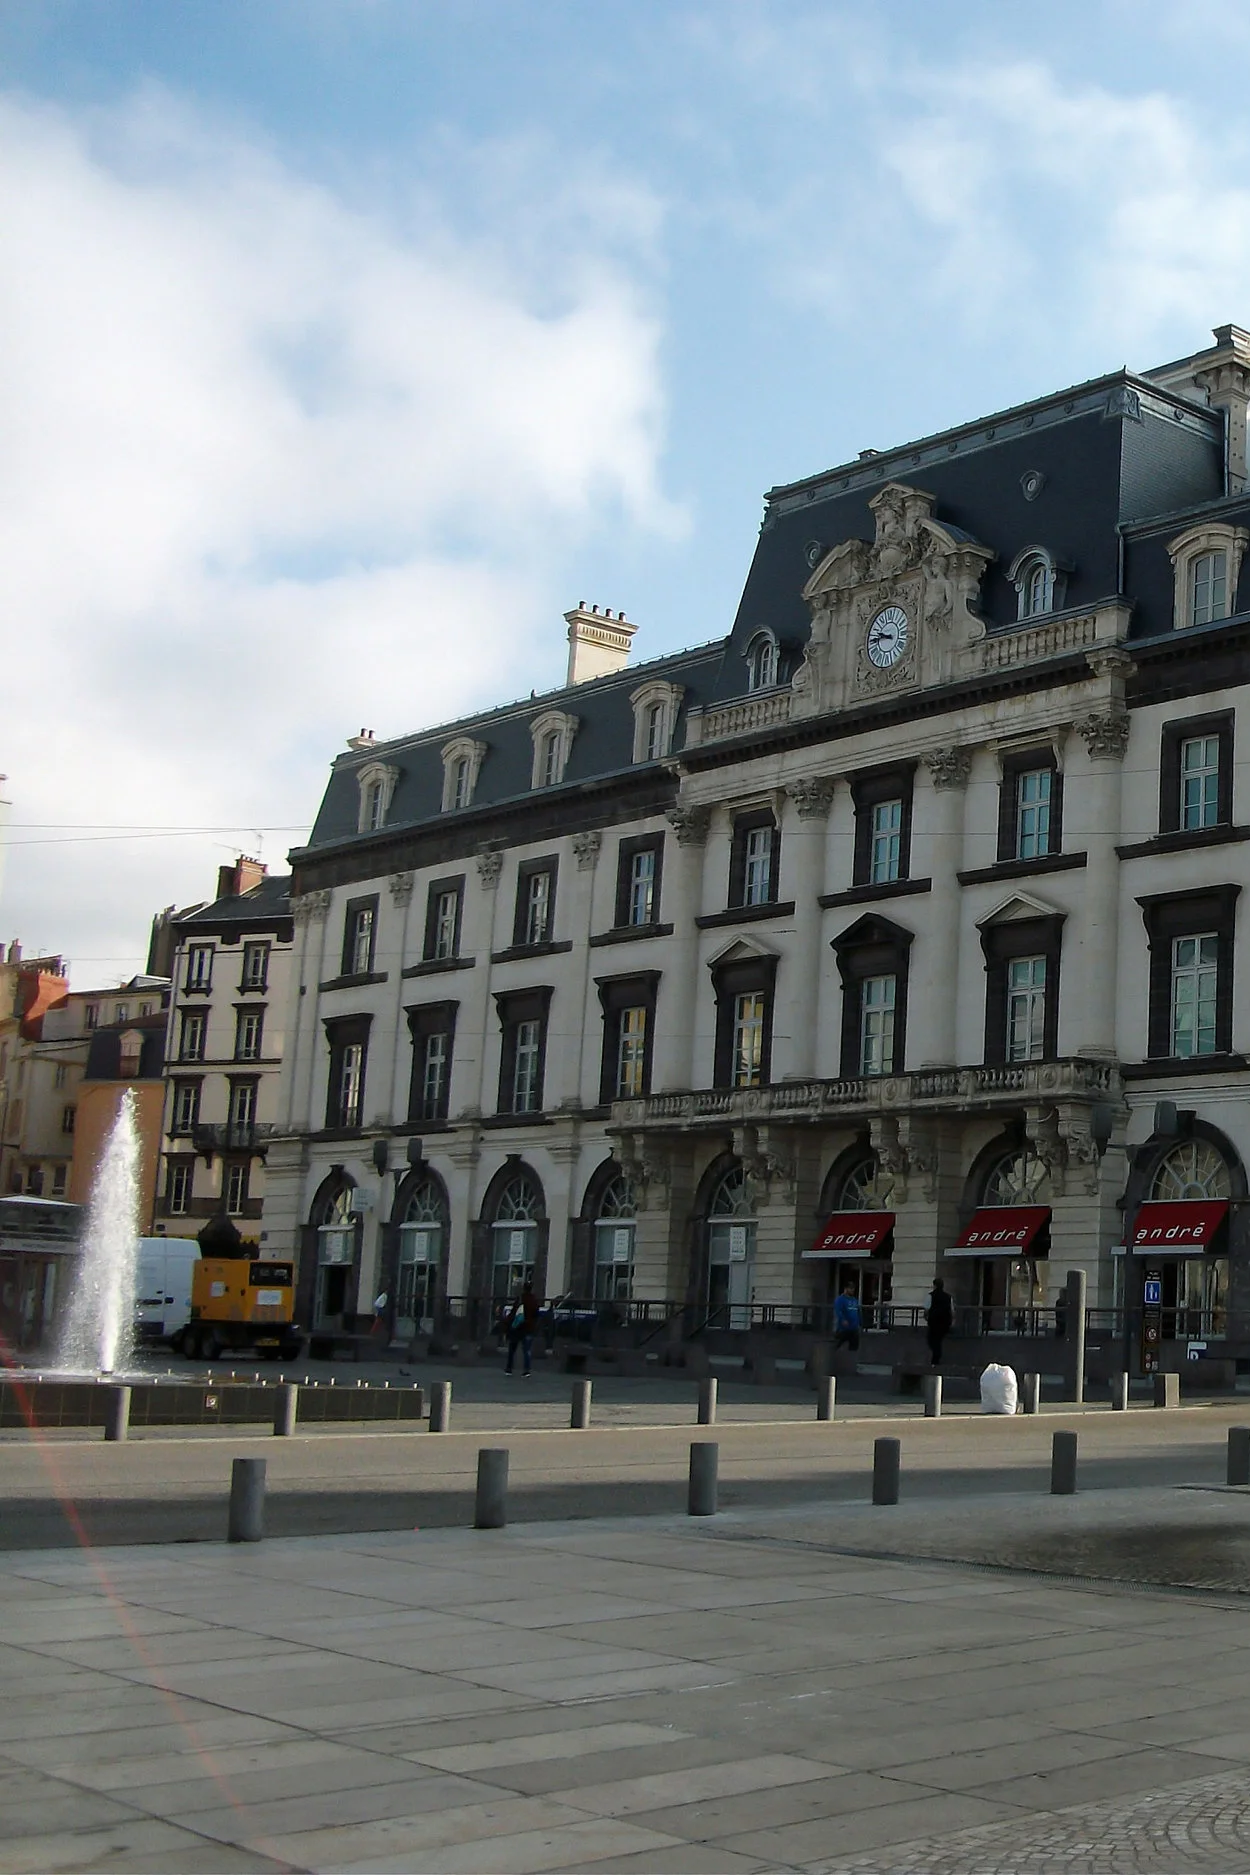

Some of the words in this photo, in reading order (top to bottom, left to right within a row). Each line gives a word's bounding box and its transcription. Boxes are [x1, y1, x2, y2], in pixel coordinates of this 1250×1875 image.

[821, 1230, 878, 1248] andré
[966, 1226, 1029, 1246] andré
[1134, 1222, 1206, 1244] andré
